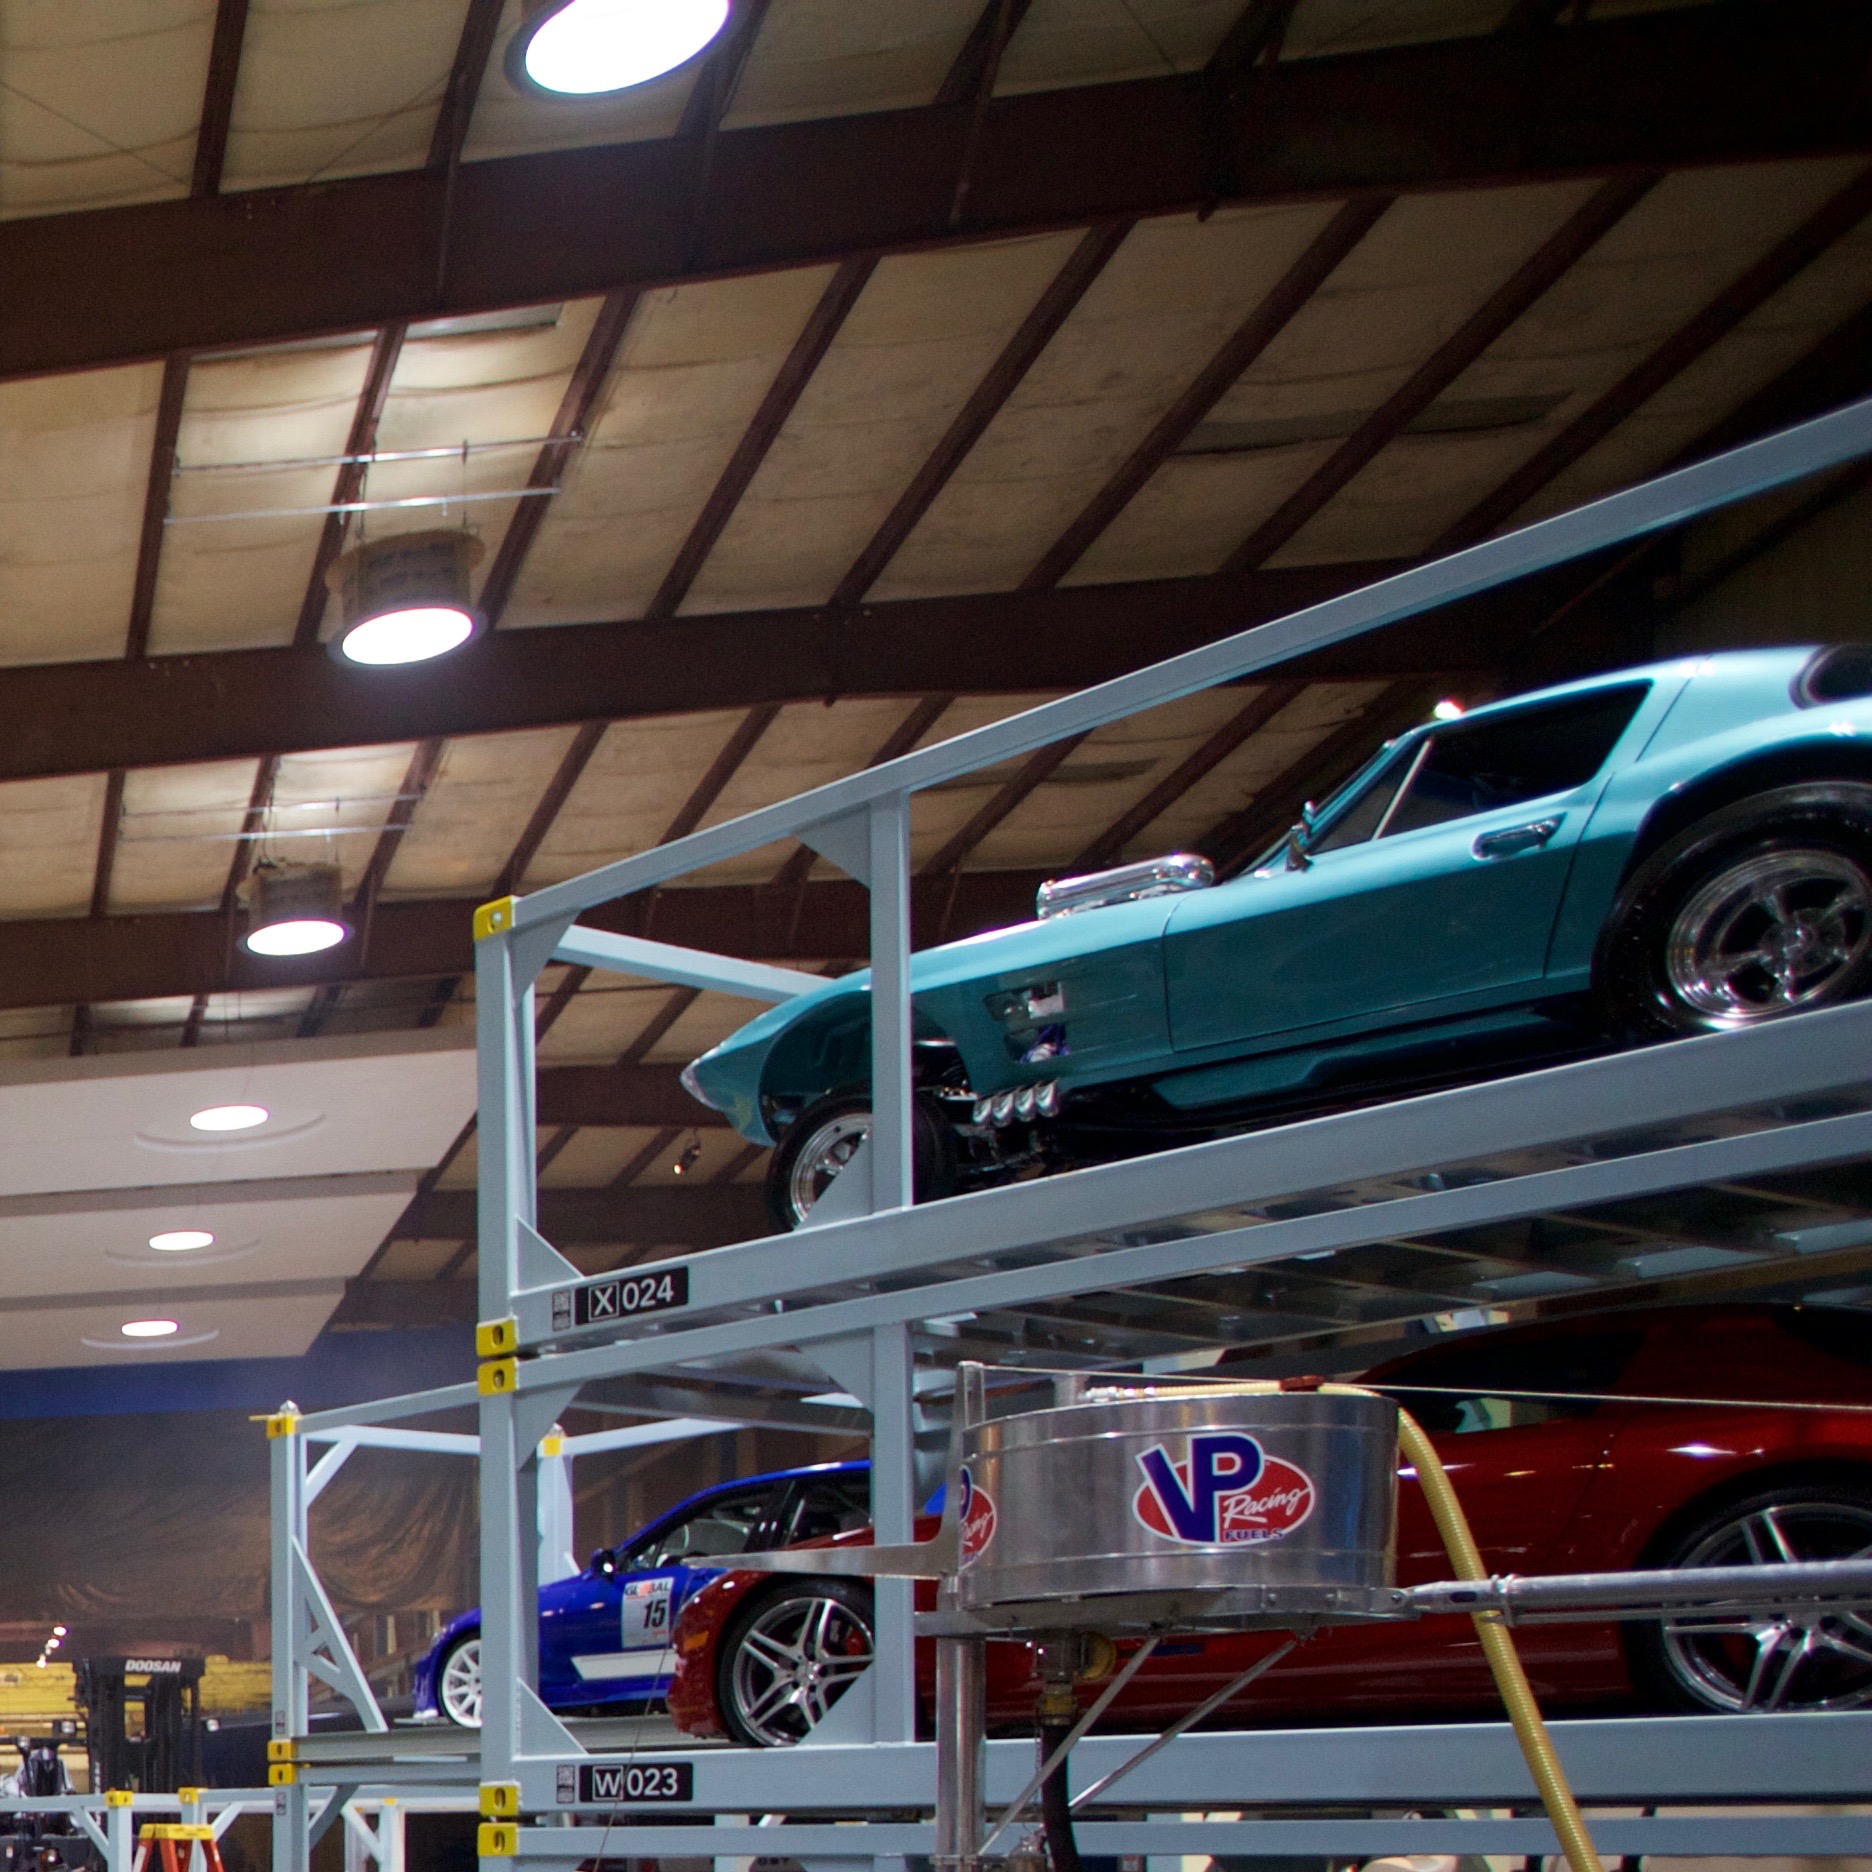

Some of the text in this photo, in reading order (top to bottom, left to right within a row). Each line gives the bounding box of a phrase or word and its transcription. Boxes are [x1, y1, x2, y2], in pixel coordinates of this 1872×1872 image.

[1134, 1431, 1264, 1544] VP
[1222, 1486, 1310, 1530] Racing
[1224, 1528, 1286, 1541] FUELS
[643, 1599, 667, 1629] 15
[124, 1658, 182, 1674] DOOSAN
